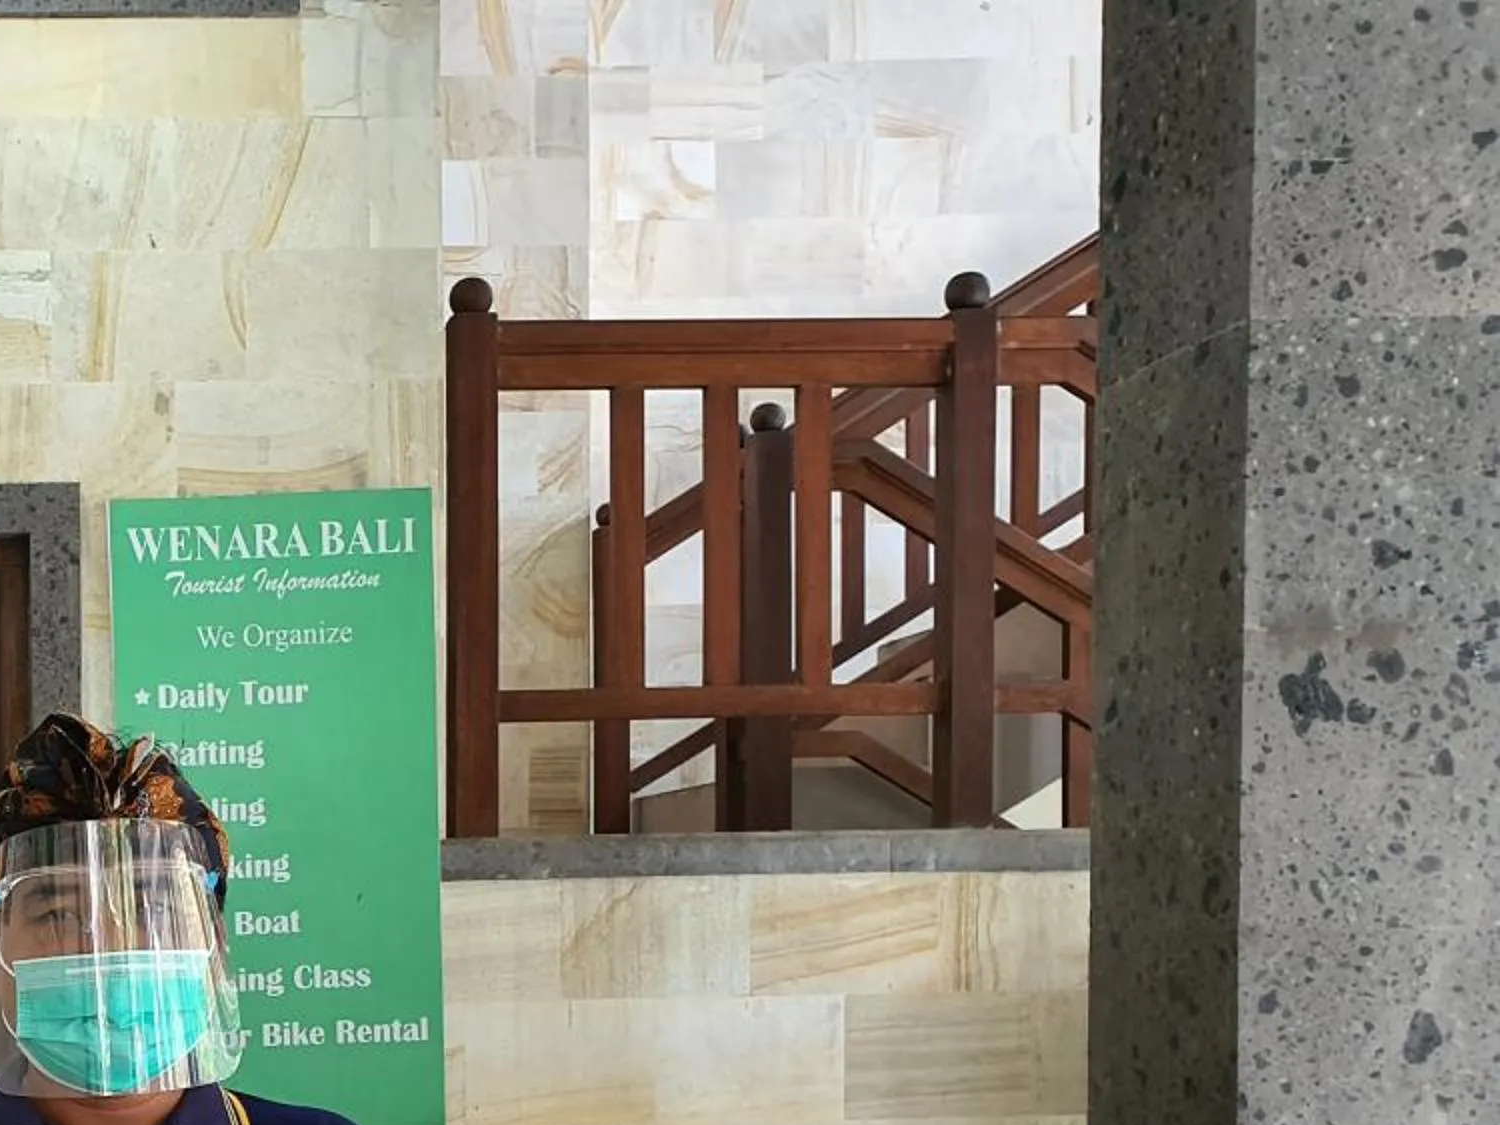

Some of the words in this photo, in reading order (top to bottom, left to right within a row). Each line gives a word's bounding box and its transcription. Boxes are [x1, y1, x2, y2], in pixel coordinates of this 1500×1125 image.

[126, 521, 310, 564] WENARA
[320, 517, 417, 557] BALI
[164, 570, 245, 597] Tourist
[252, 567, 381, 599] Information
[196, 624, 236, 650] We
[243, 620, 353, 652] Organize
[157, 682, 231, 713] Daily
[240, 680, 309, 706] Tour
[211, 797, 267, 827] ling
[228, 854, 291, 883] king
[234, 910, 302, 936] Boat
[293, 963, 372, 990] Class
[262, 1020, 326, 1047] Bike
[336, 1017, 429, 1045] Rental
